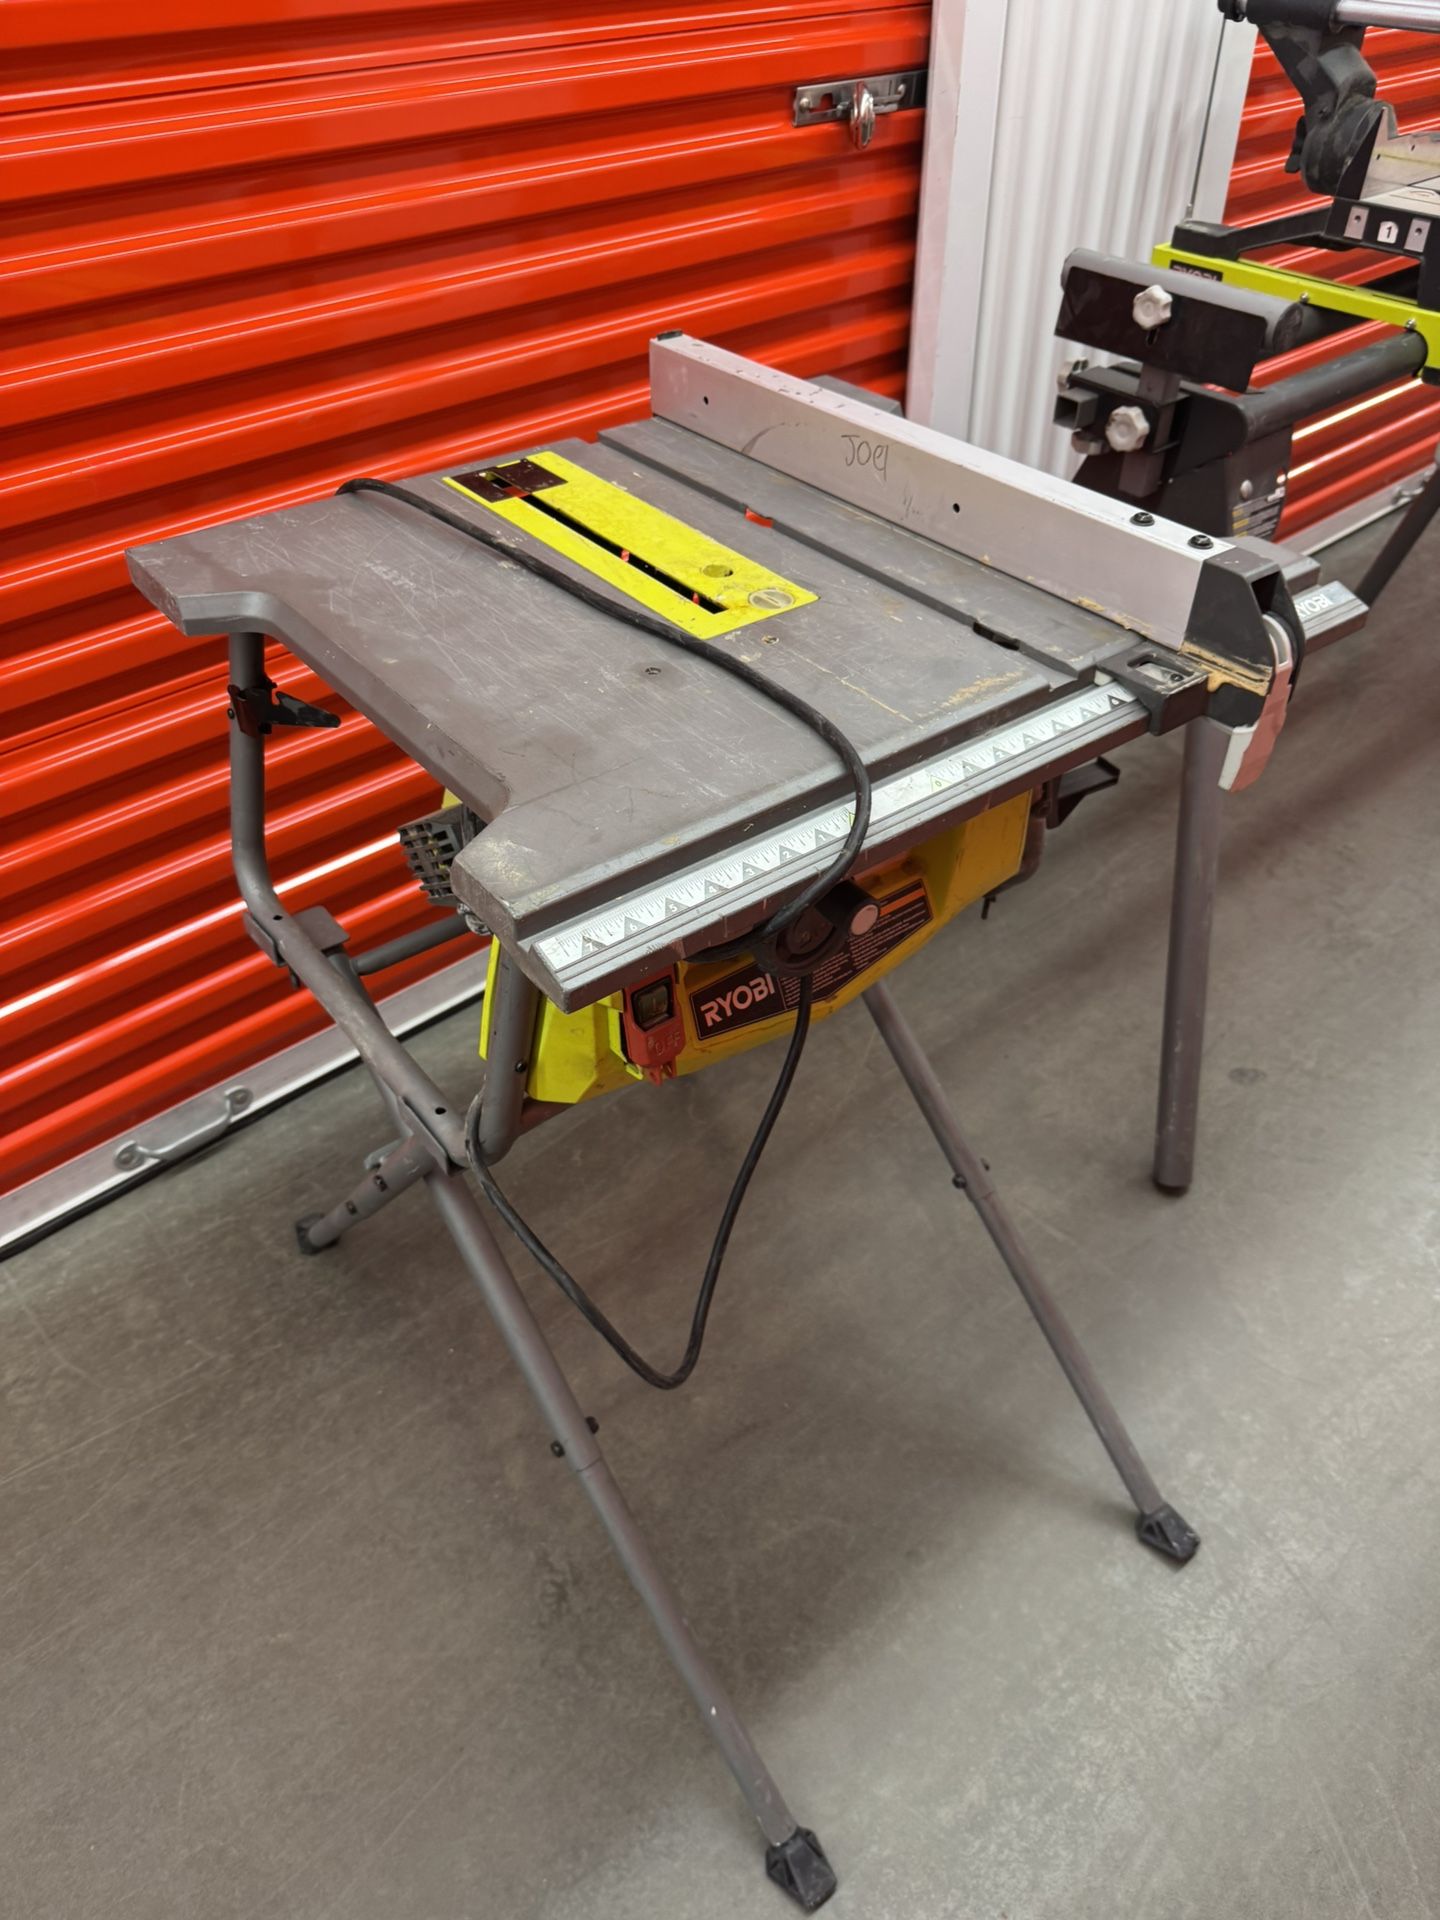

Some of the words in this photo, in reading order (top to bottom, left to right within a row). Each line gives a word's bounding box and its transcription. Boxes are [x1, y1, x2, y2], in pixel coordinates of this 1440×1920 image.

[1386, 225, 1393, 239] 1
[1295, 593, 1333, 617] YOBI
[629, 923, 638, 931] 6
[668, 904, 678, 912] 5
[708, 885, 717, 893] 4
[745, 868, 754, 876] 3
[782, 851, 792, 859] 2
[700, 972, 775, 1027] RYOBI
